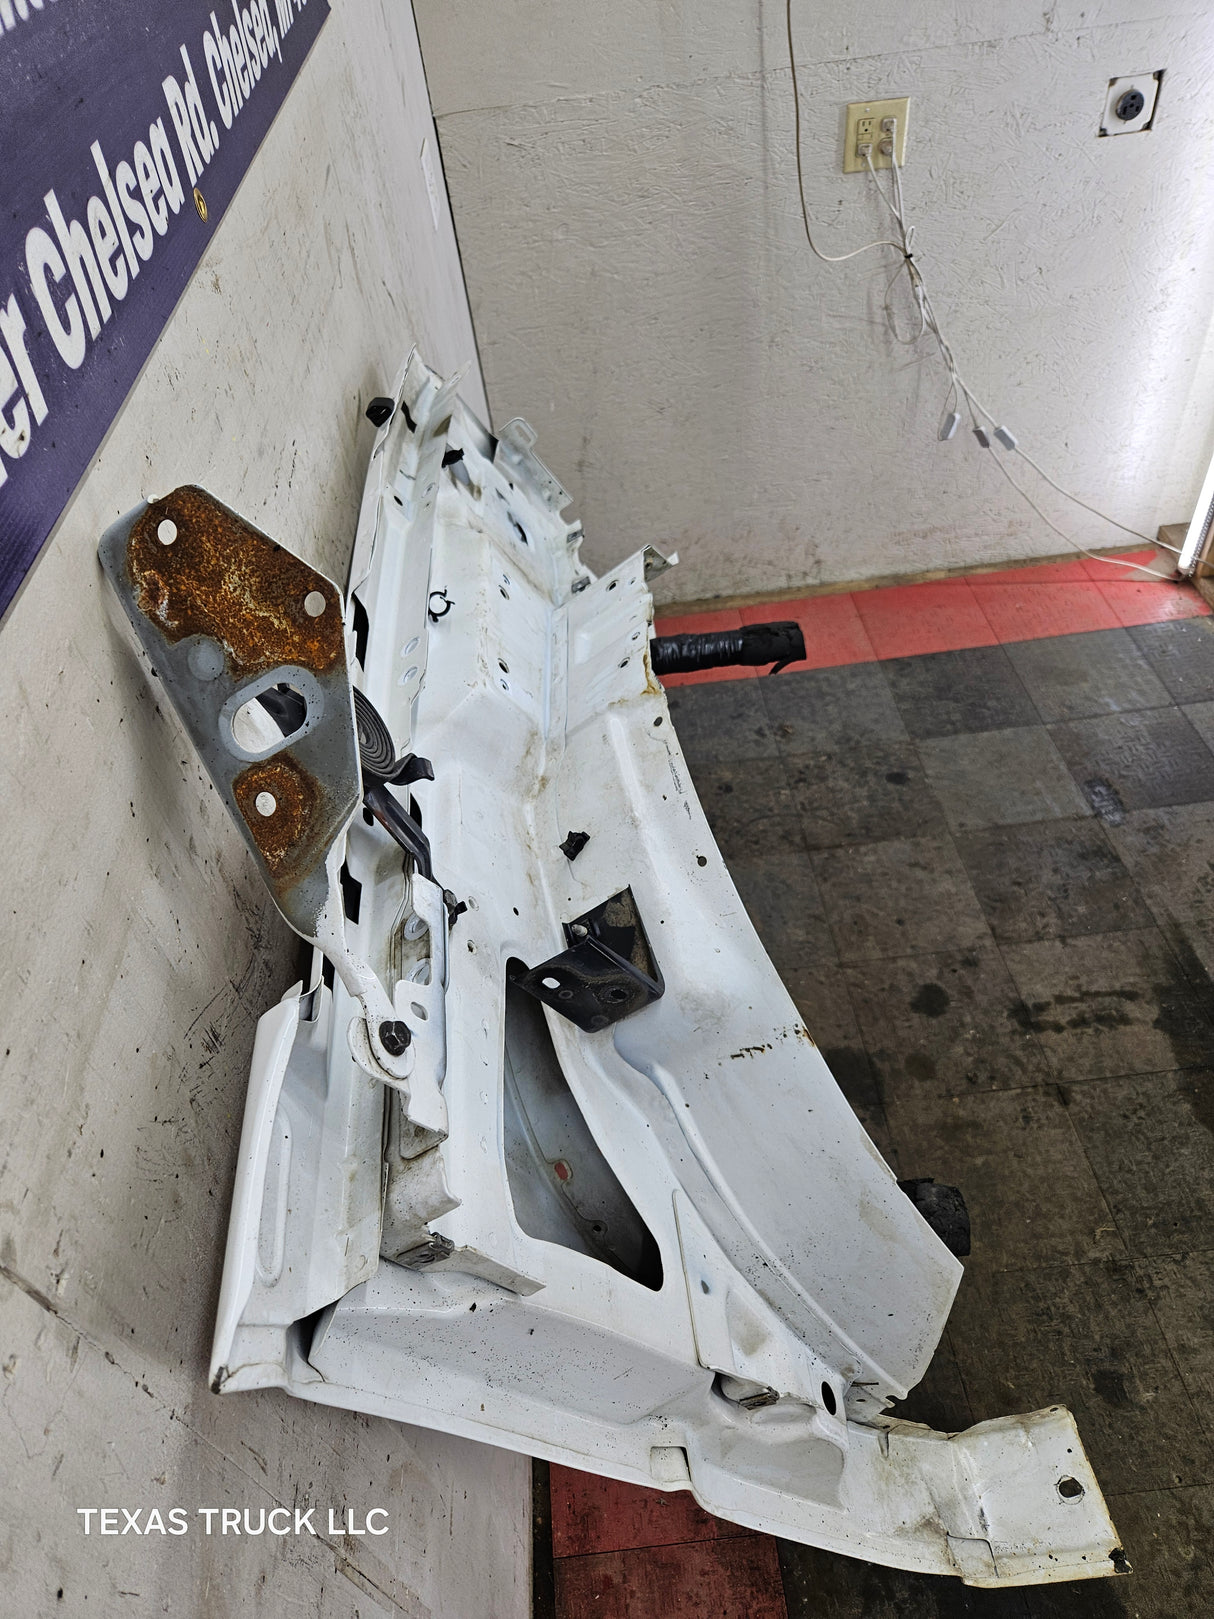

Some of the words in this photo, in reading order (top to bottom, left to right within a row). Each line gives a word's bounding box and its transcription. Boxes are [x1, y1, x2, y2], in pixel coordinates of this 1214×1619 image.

[25, 139, 185, 369] Chelsea
[161, 43, 219, 188] Rd.
[203, 0, 282, 130] Chelsea,
